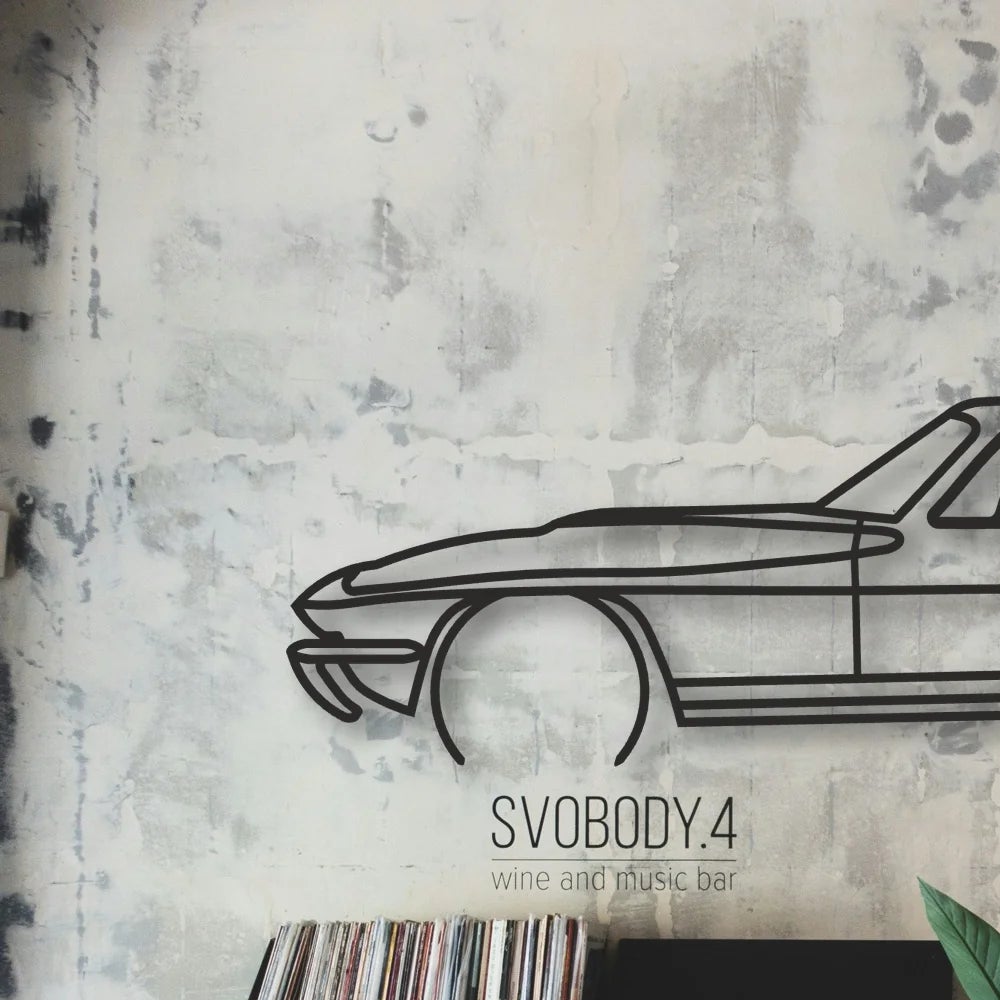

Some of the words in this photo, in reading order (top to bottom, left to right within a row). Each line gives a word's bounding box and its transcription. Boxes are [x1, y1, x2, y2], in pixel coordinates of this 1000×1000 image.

[491, 795, 737, 849] SVOBODY.4
[491, 867, 550, 891] wine
[560, 866, 606, 891] and
[615, 867, 688, 891] music
[697, 866, 737, 891] bar
